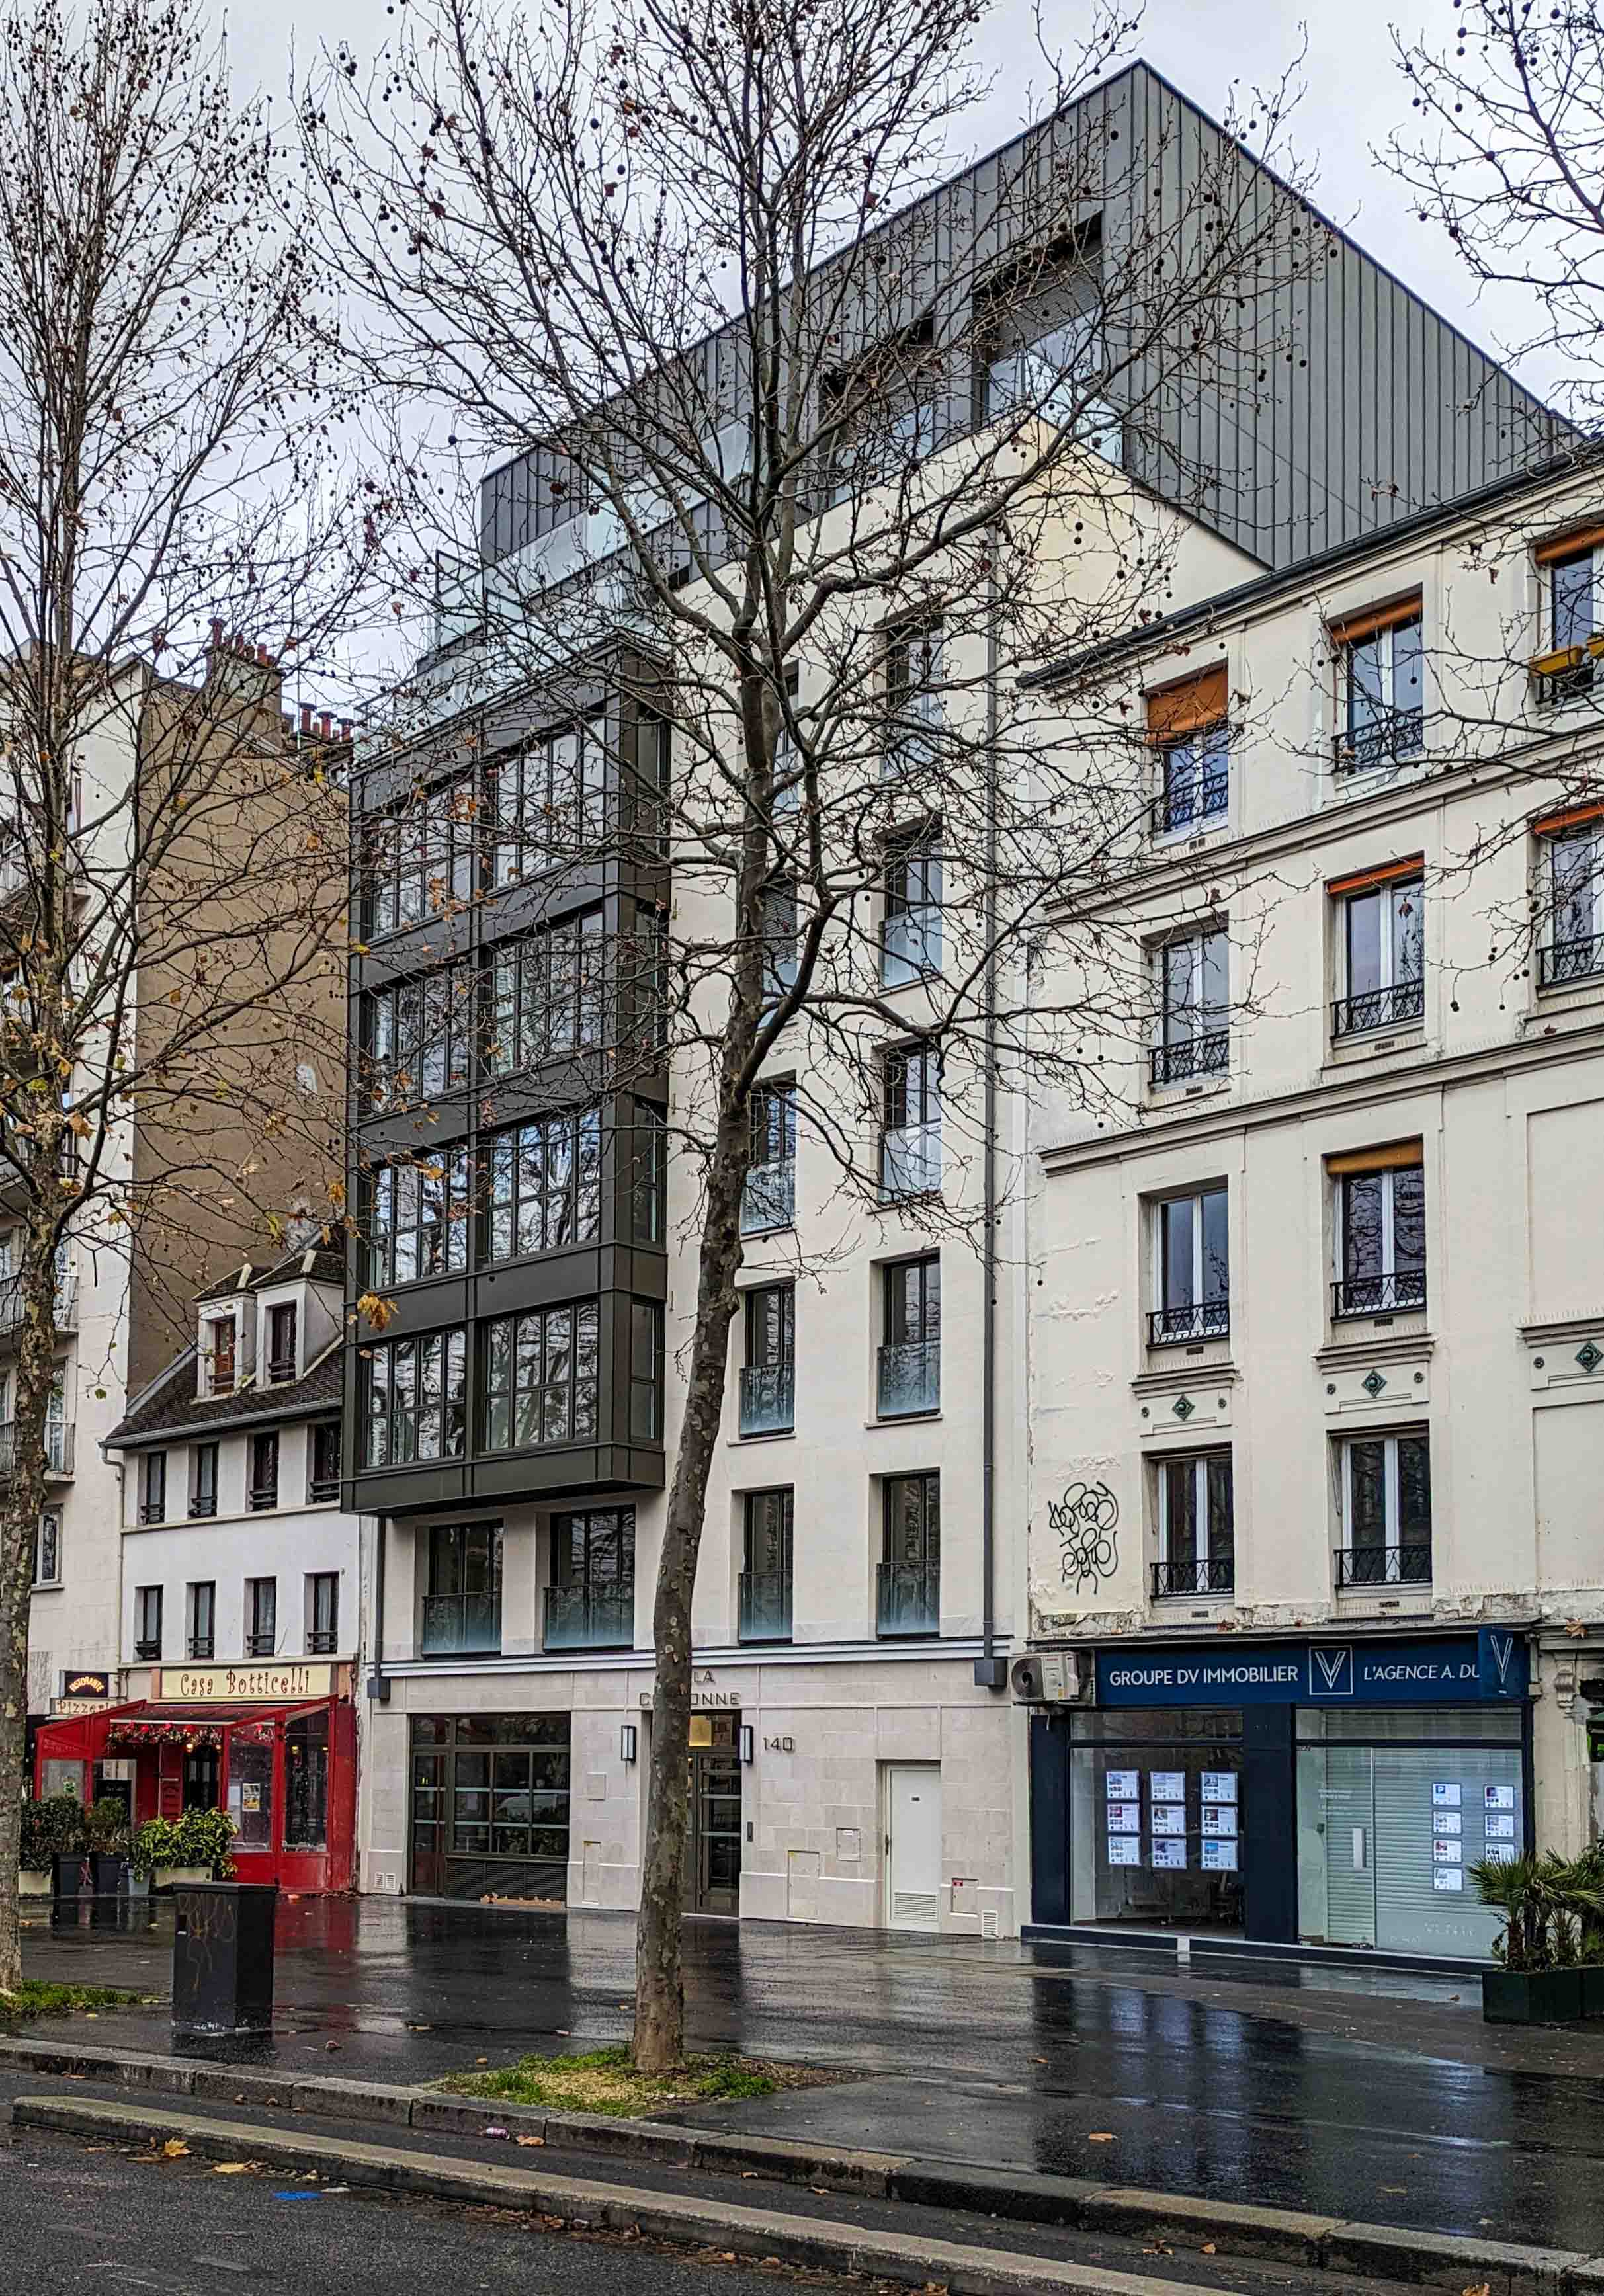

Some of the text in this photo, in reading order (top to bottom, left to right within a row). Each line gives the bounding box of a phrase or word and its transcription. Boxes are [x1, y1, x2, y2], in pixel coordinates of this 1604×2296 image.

[1109, 1666, 1298, 1686] GROUPE DV IMMOBILIER
[1364, 1664, 1439, 1680] L'AGENCE
[1441, 1665, 1455, 1679] A.
[180, 1667, 310, 1696] Casa Botticelli
[763, 1737, 793, 1751] 140
